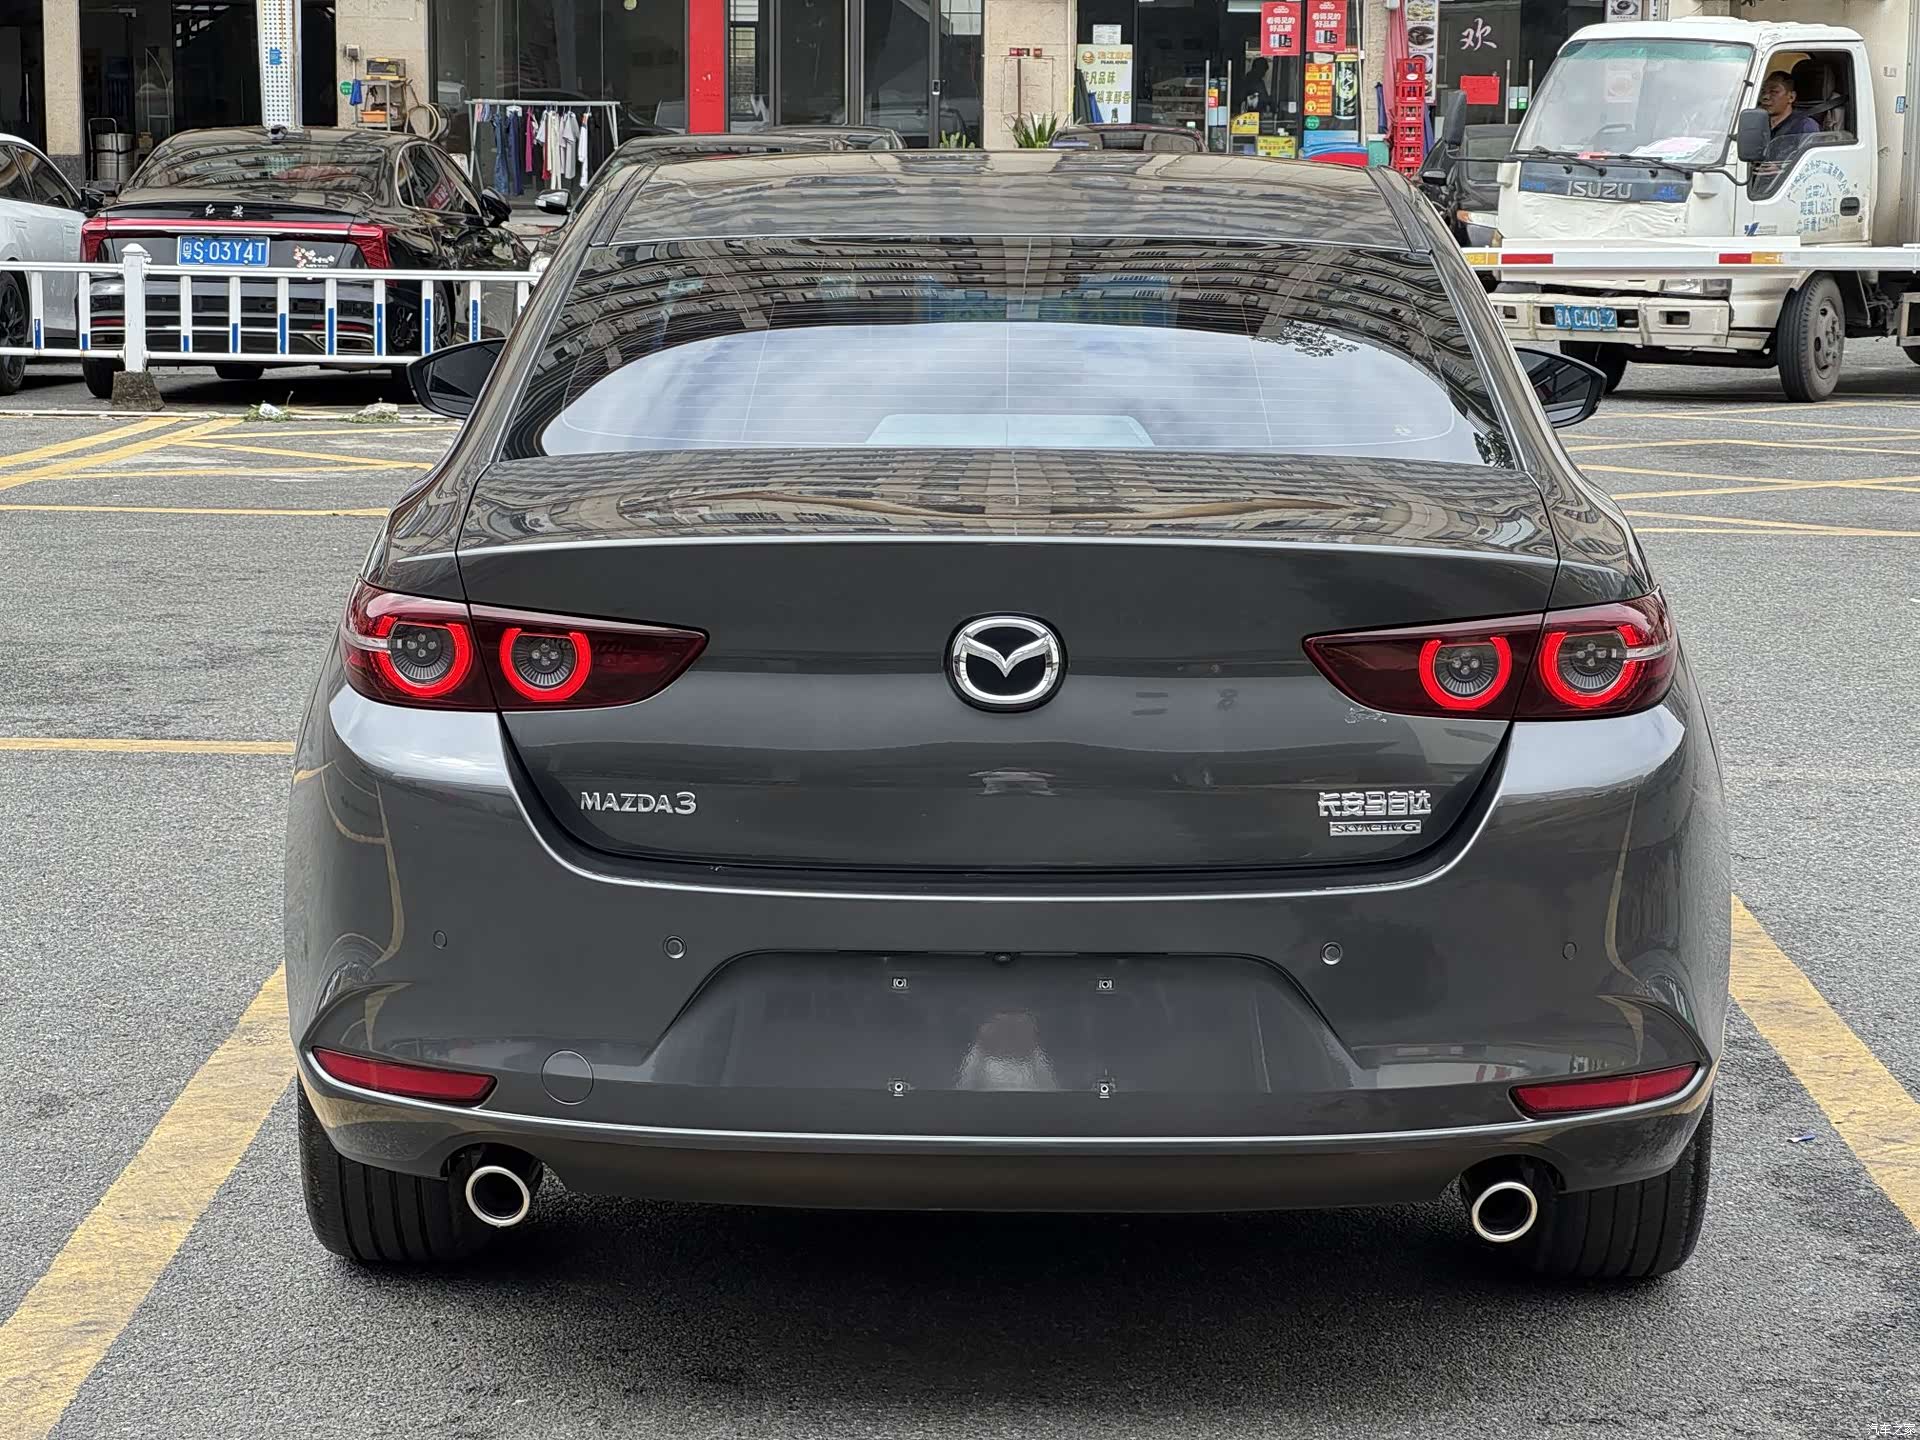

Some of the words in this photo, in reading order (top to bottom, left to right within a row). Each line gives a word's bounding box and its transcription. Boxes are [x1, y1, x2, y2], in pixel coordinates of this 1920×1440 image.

[1460, 17, 1498, 51] 欢
[1566, 180, 1633, 200] ISUZU
[580, 791, 697, 815] MAZDA3
[1318, 789, 1432, 817] 长安马自达
